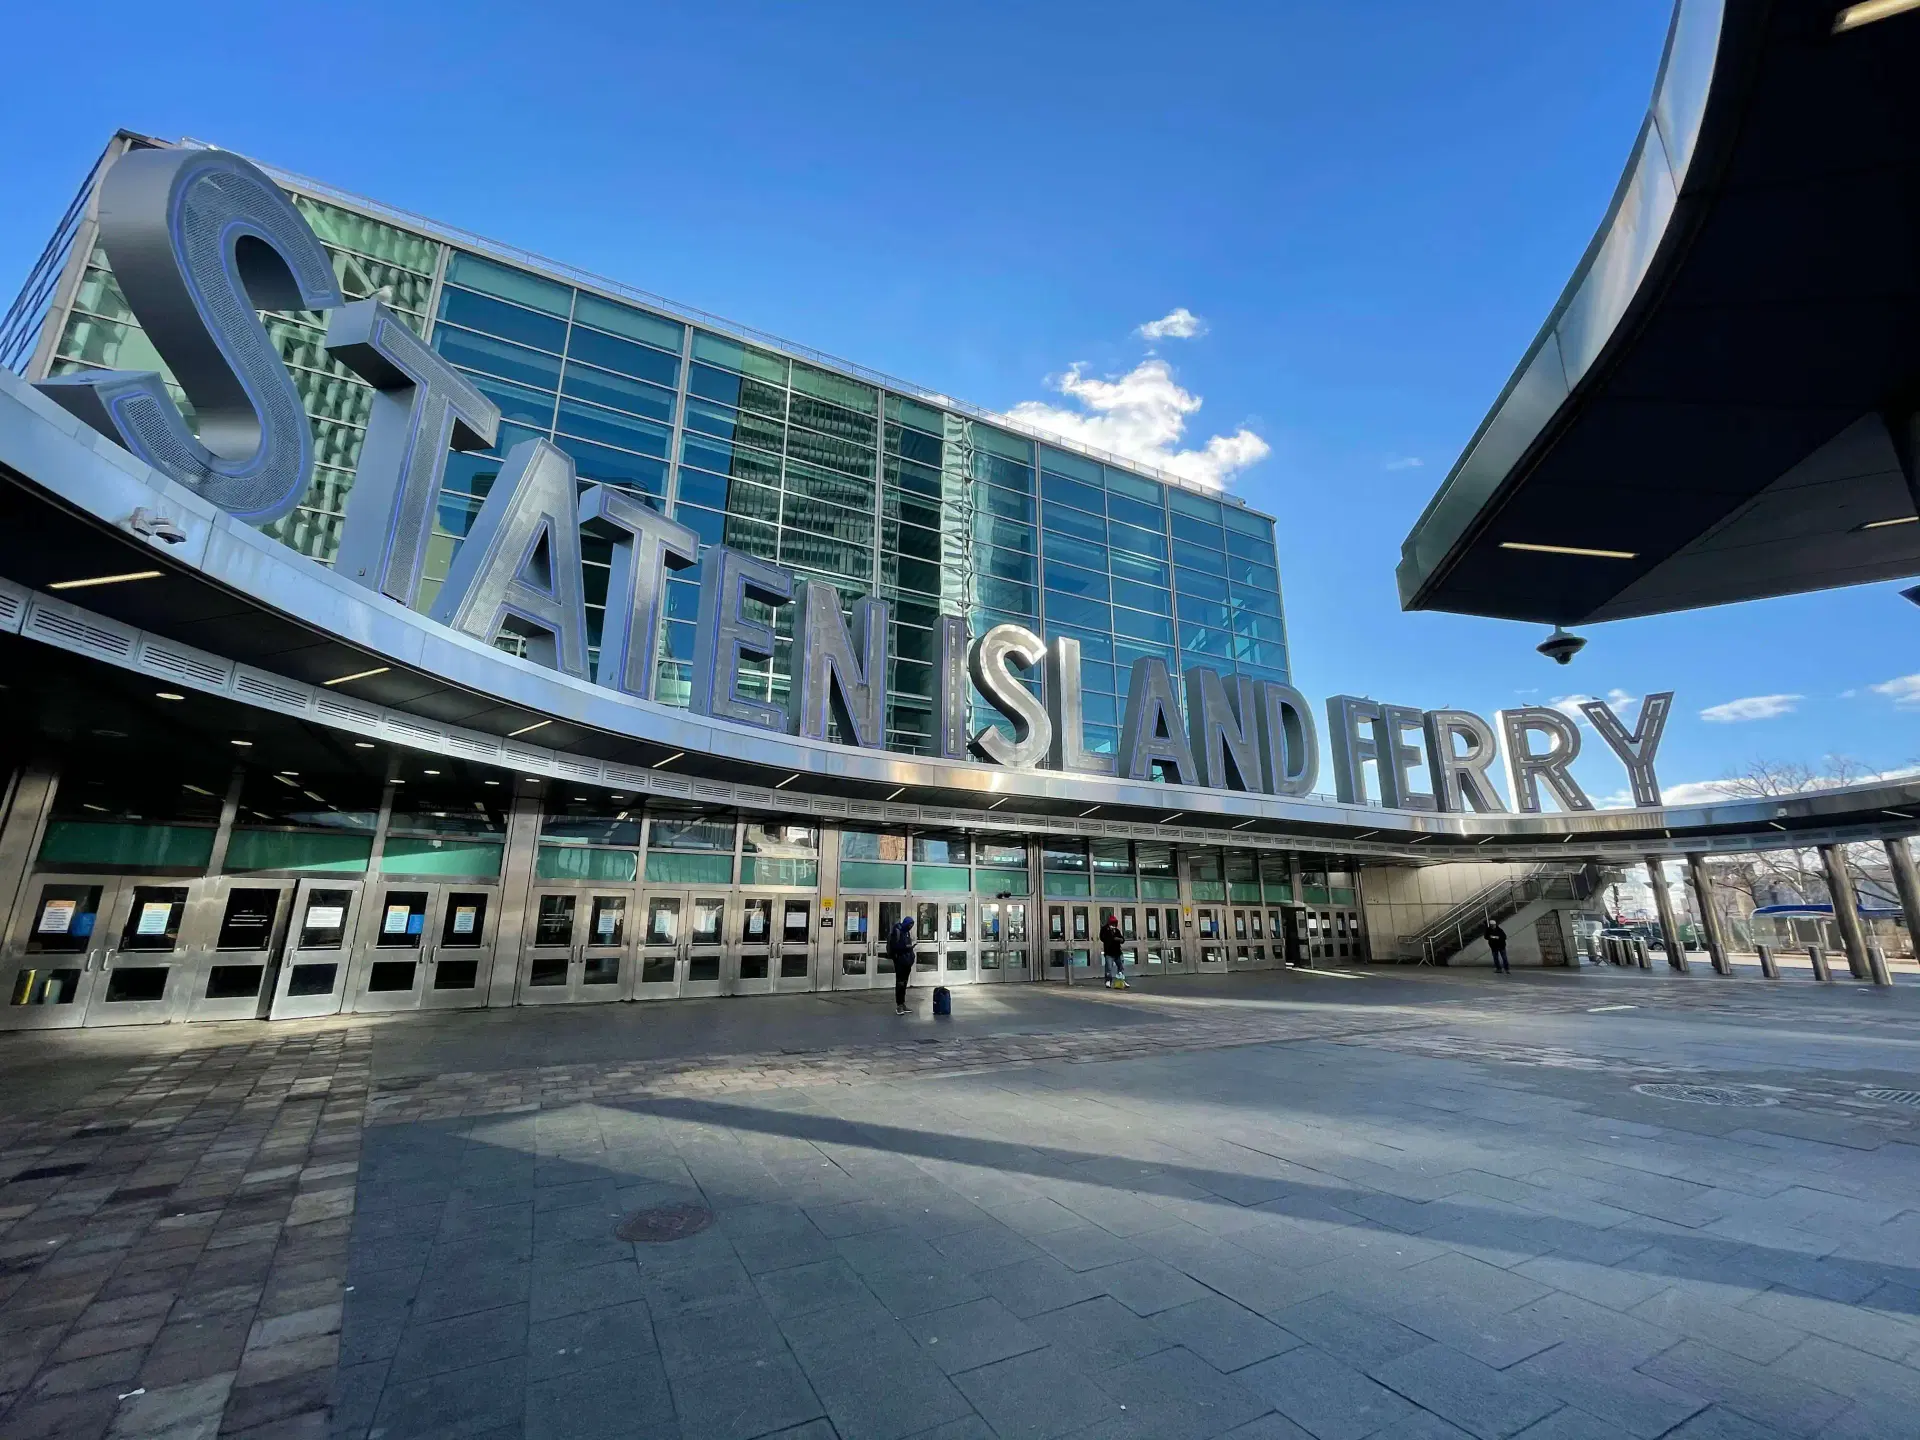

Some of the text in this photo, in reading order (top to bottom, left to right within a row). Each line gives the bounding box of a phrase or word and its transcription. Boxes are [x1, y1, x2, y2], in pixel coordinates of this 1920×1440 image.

[35, 148, 1674, 814] STATEN ISLAND FERRY
